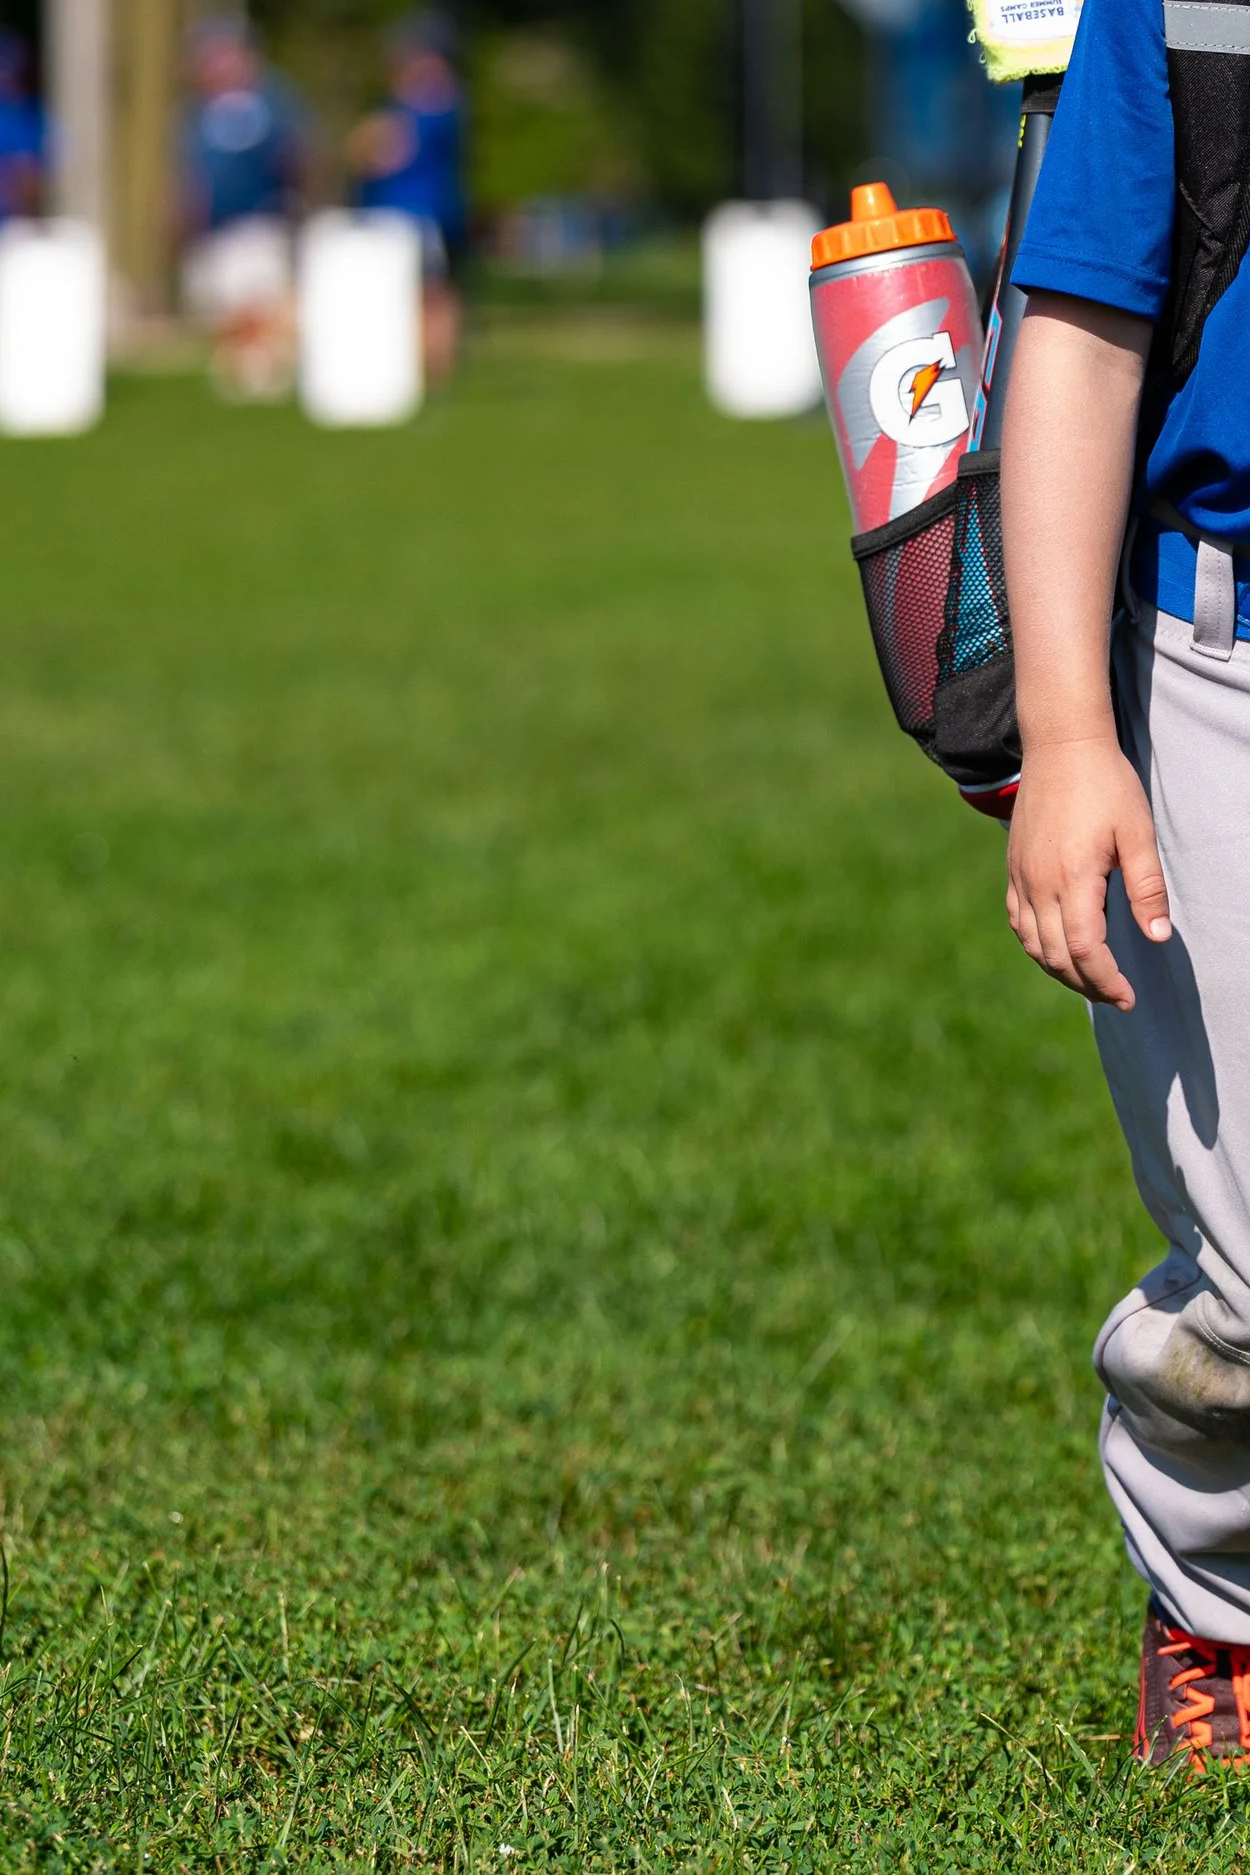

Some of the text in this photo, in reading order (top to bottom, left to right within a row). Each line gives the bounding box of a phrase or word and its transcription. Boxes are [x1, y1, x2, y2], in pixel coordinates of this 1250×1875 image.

[1000, 3, 1028, 12] CAMPS
[1001, 7, 1064, 24] BASEBALL
[869, 331, 970, 448] G
